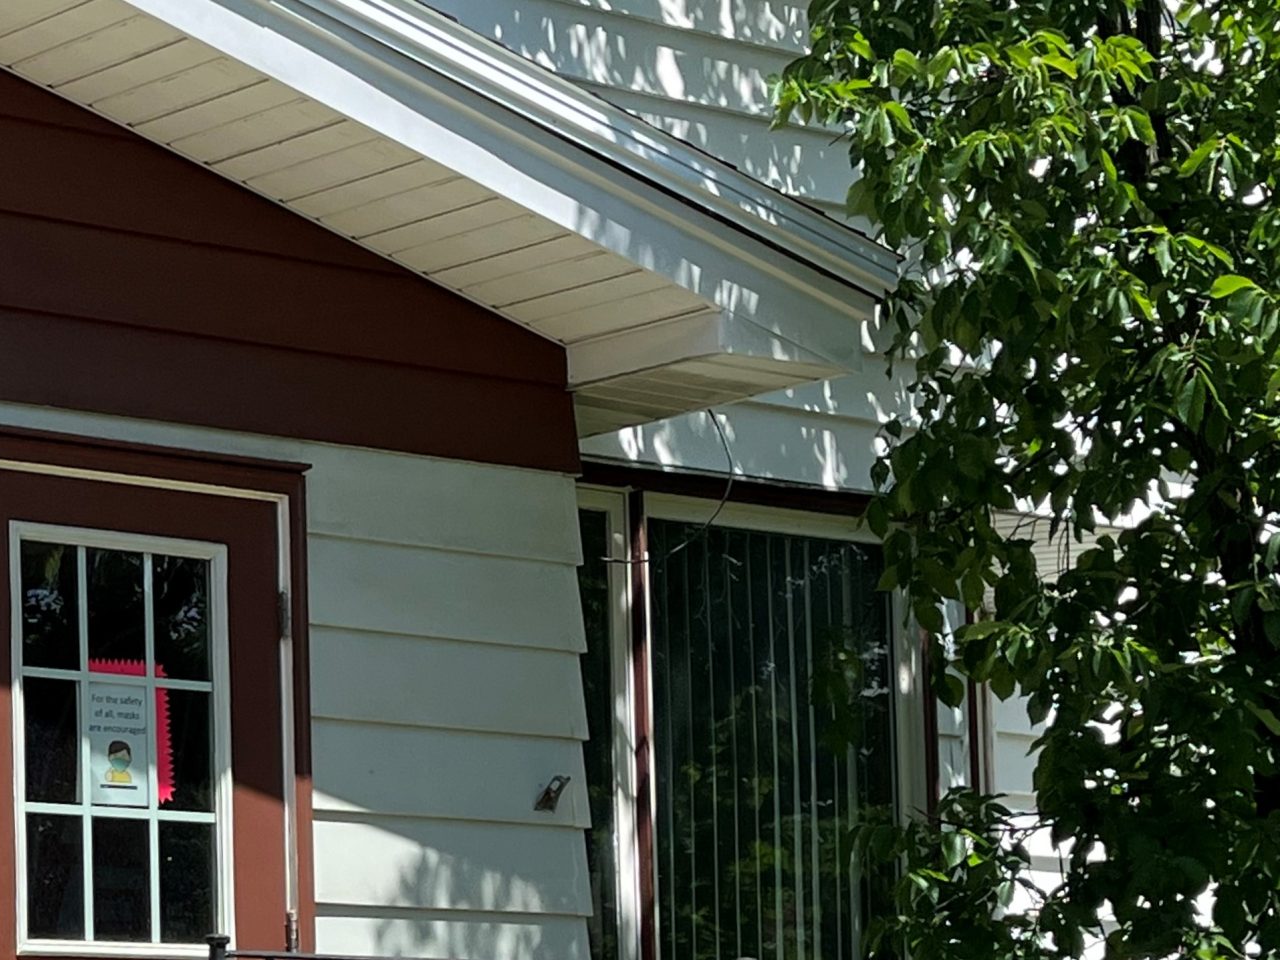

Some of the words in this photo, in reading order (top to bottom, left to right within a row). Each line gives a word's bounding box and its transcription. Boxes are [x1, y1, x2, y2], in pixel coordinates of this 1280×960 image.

[106, 696, 118, 704] the
[120, 696, 143, 707] safety
[116, 711, 140, 720] masks
